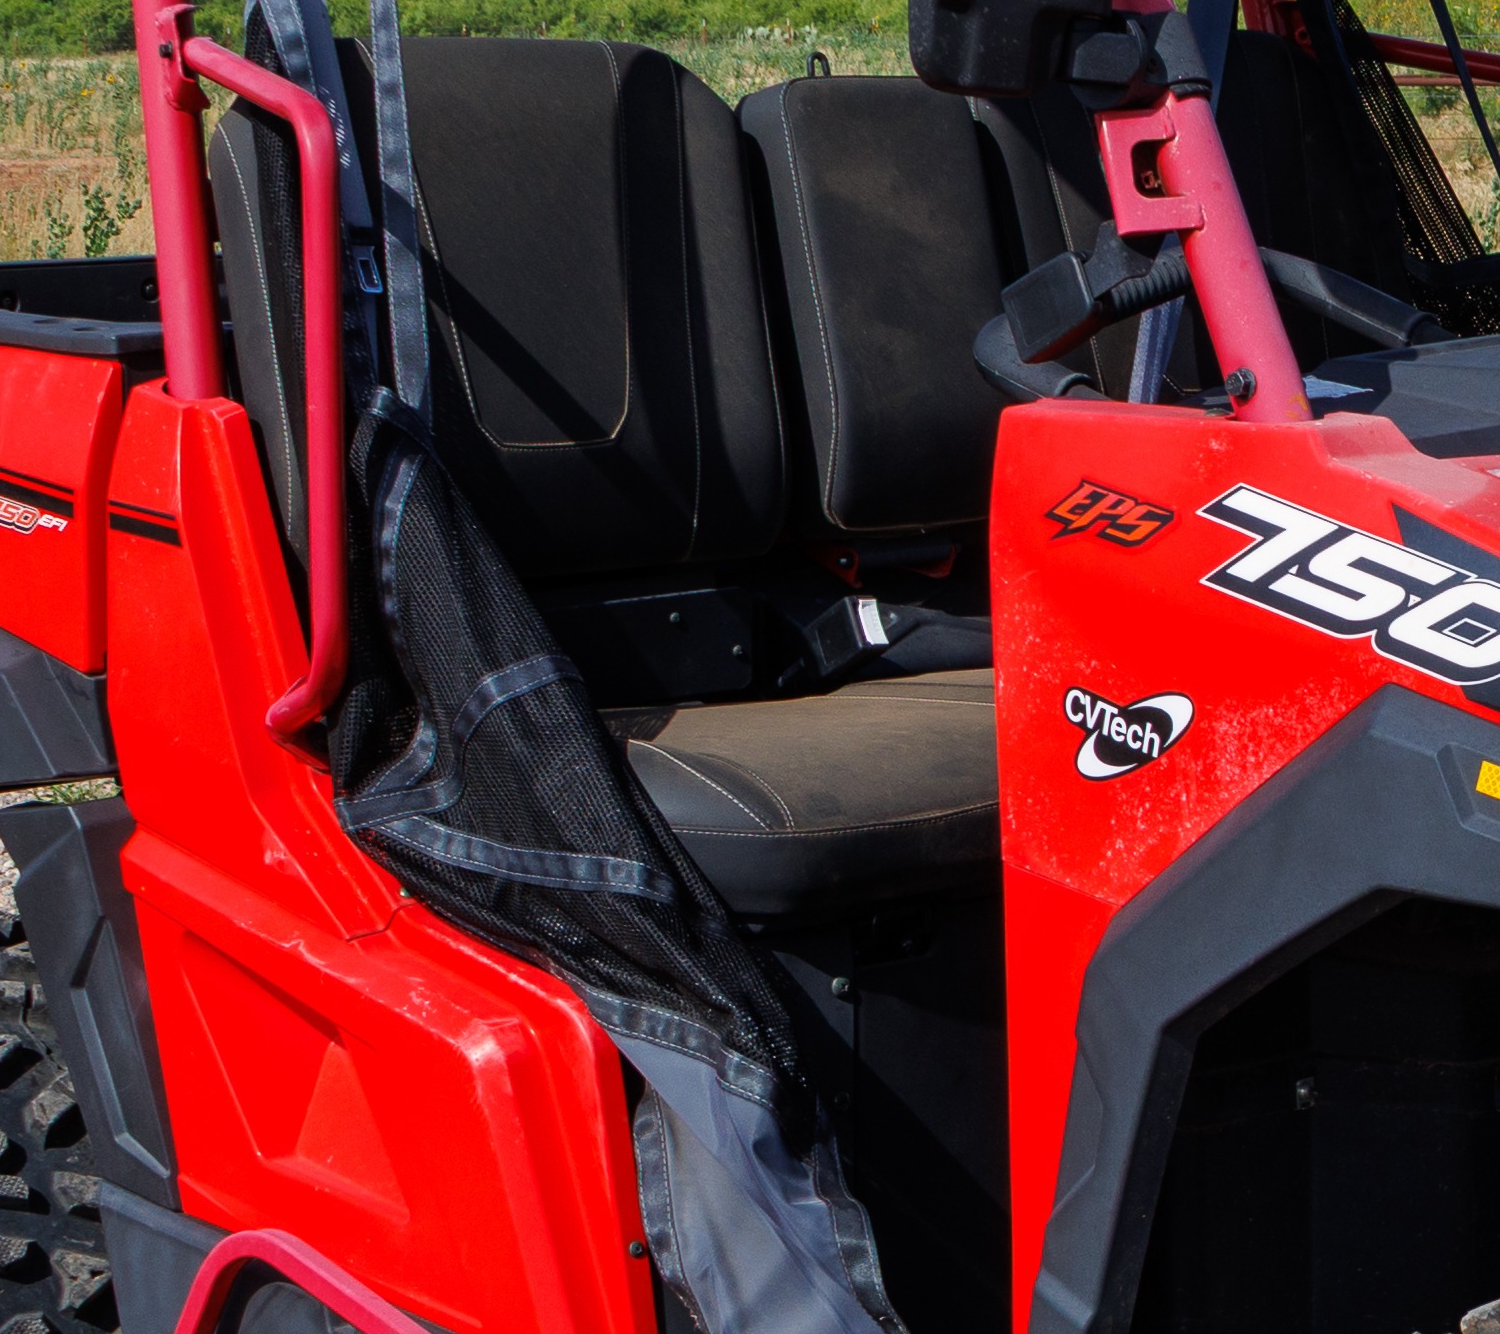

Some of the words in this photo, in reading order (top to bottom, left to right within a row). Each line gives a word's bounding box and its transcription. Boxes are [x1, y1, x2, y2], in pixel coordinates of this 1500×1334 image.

[38, 514, 69, 532] EFI
[1048, 481, 1173, 545] EPS
[1065, 689, 1161, 758] CVTech
